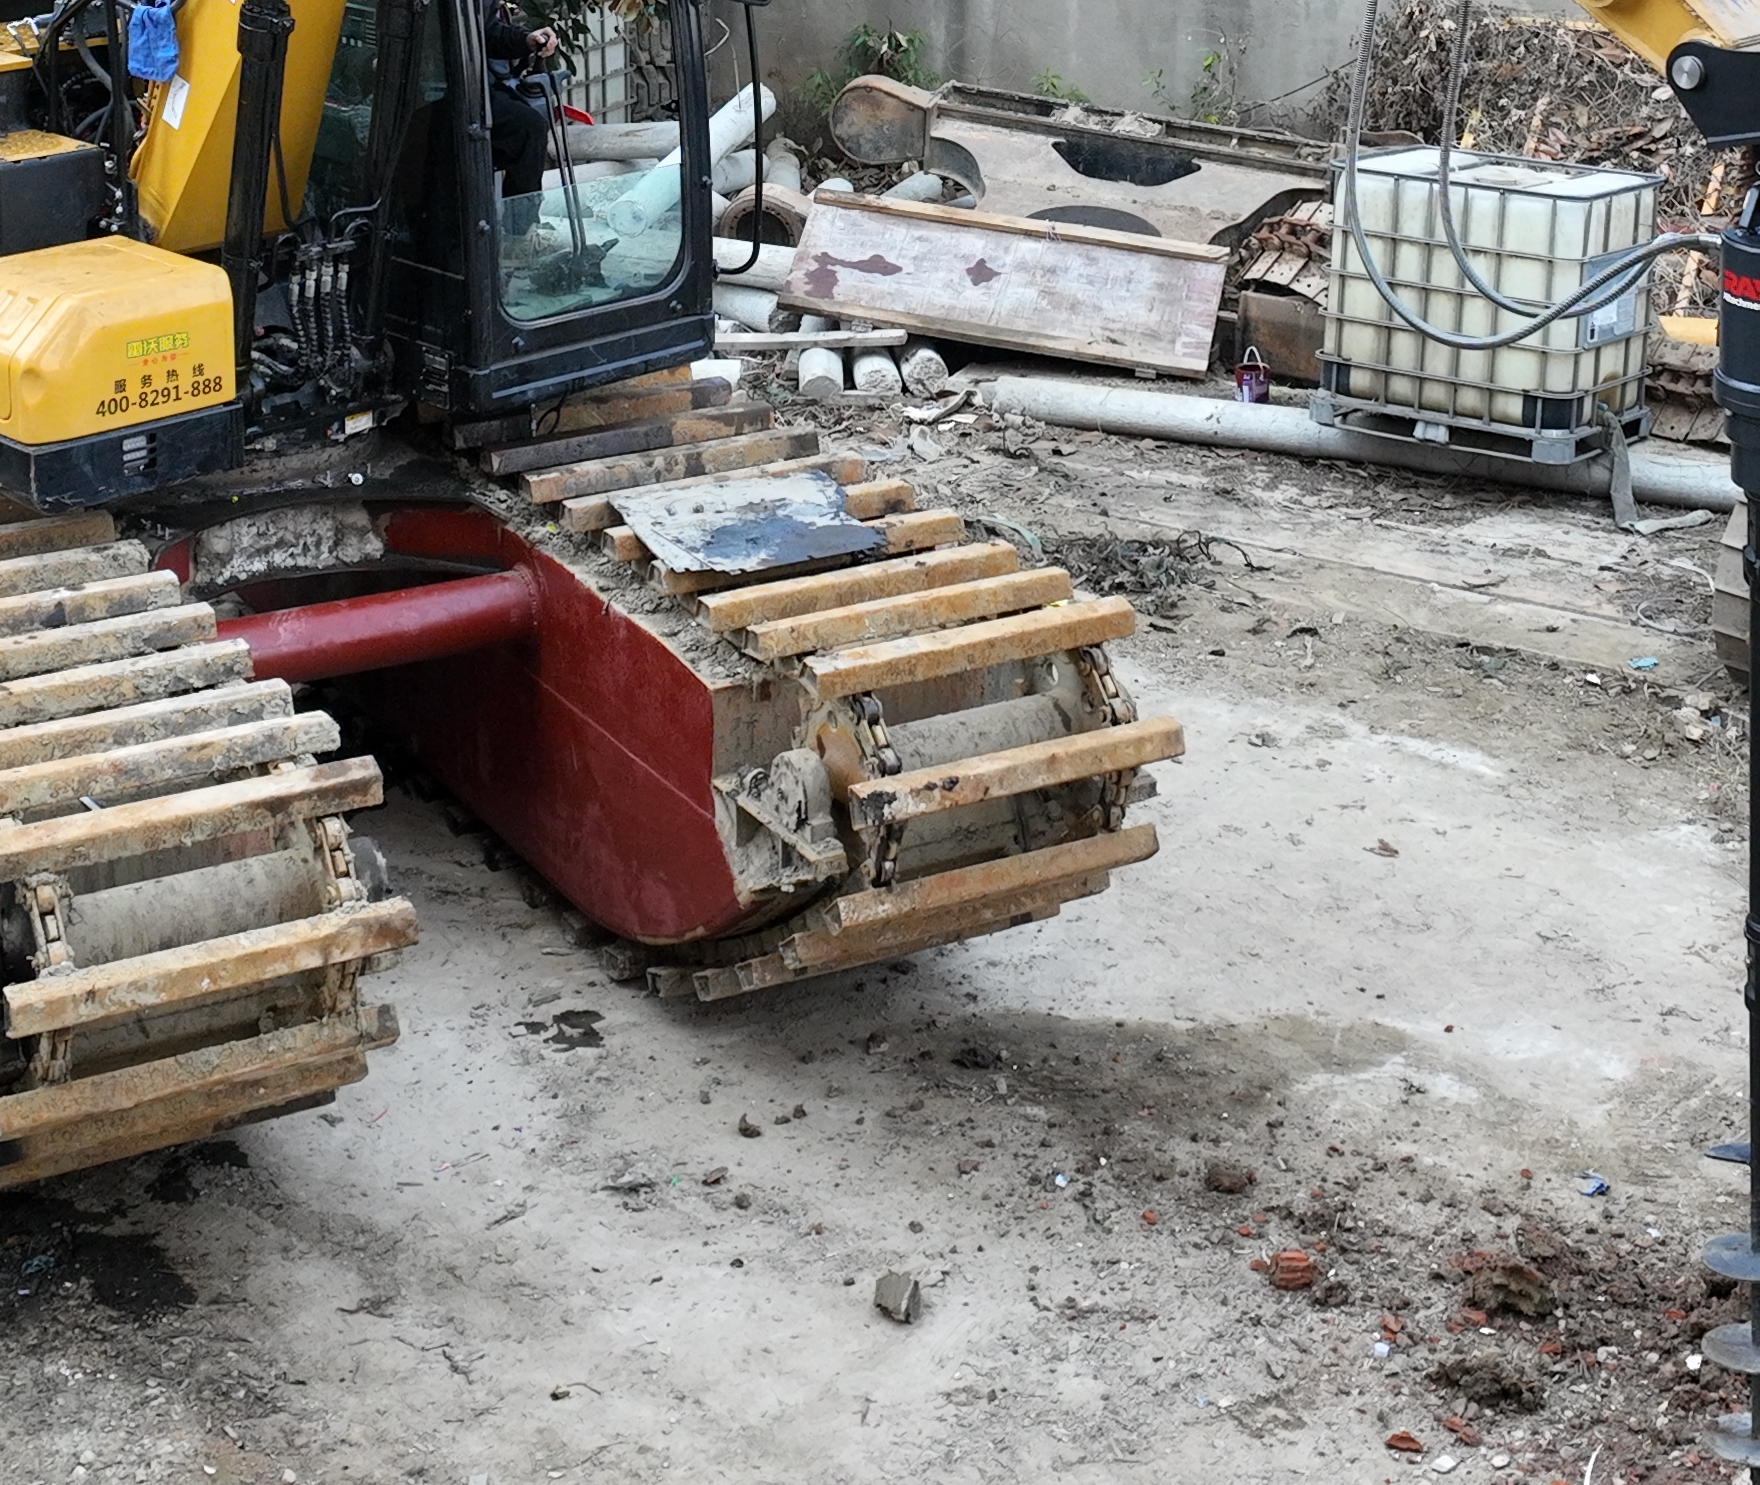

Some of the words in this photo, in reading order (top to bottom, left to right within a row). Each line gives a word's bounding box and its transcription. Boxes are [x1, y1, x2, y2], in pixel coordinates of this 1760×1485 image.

[96, 376, 223, 417] 400-8291-888
[114, 363, 205, 394] 服务热线
